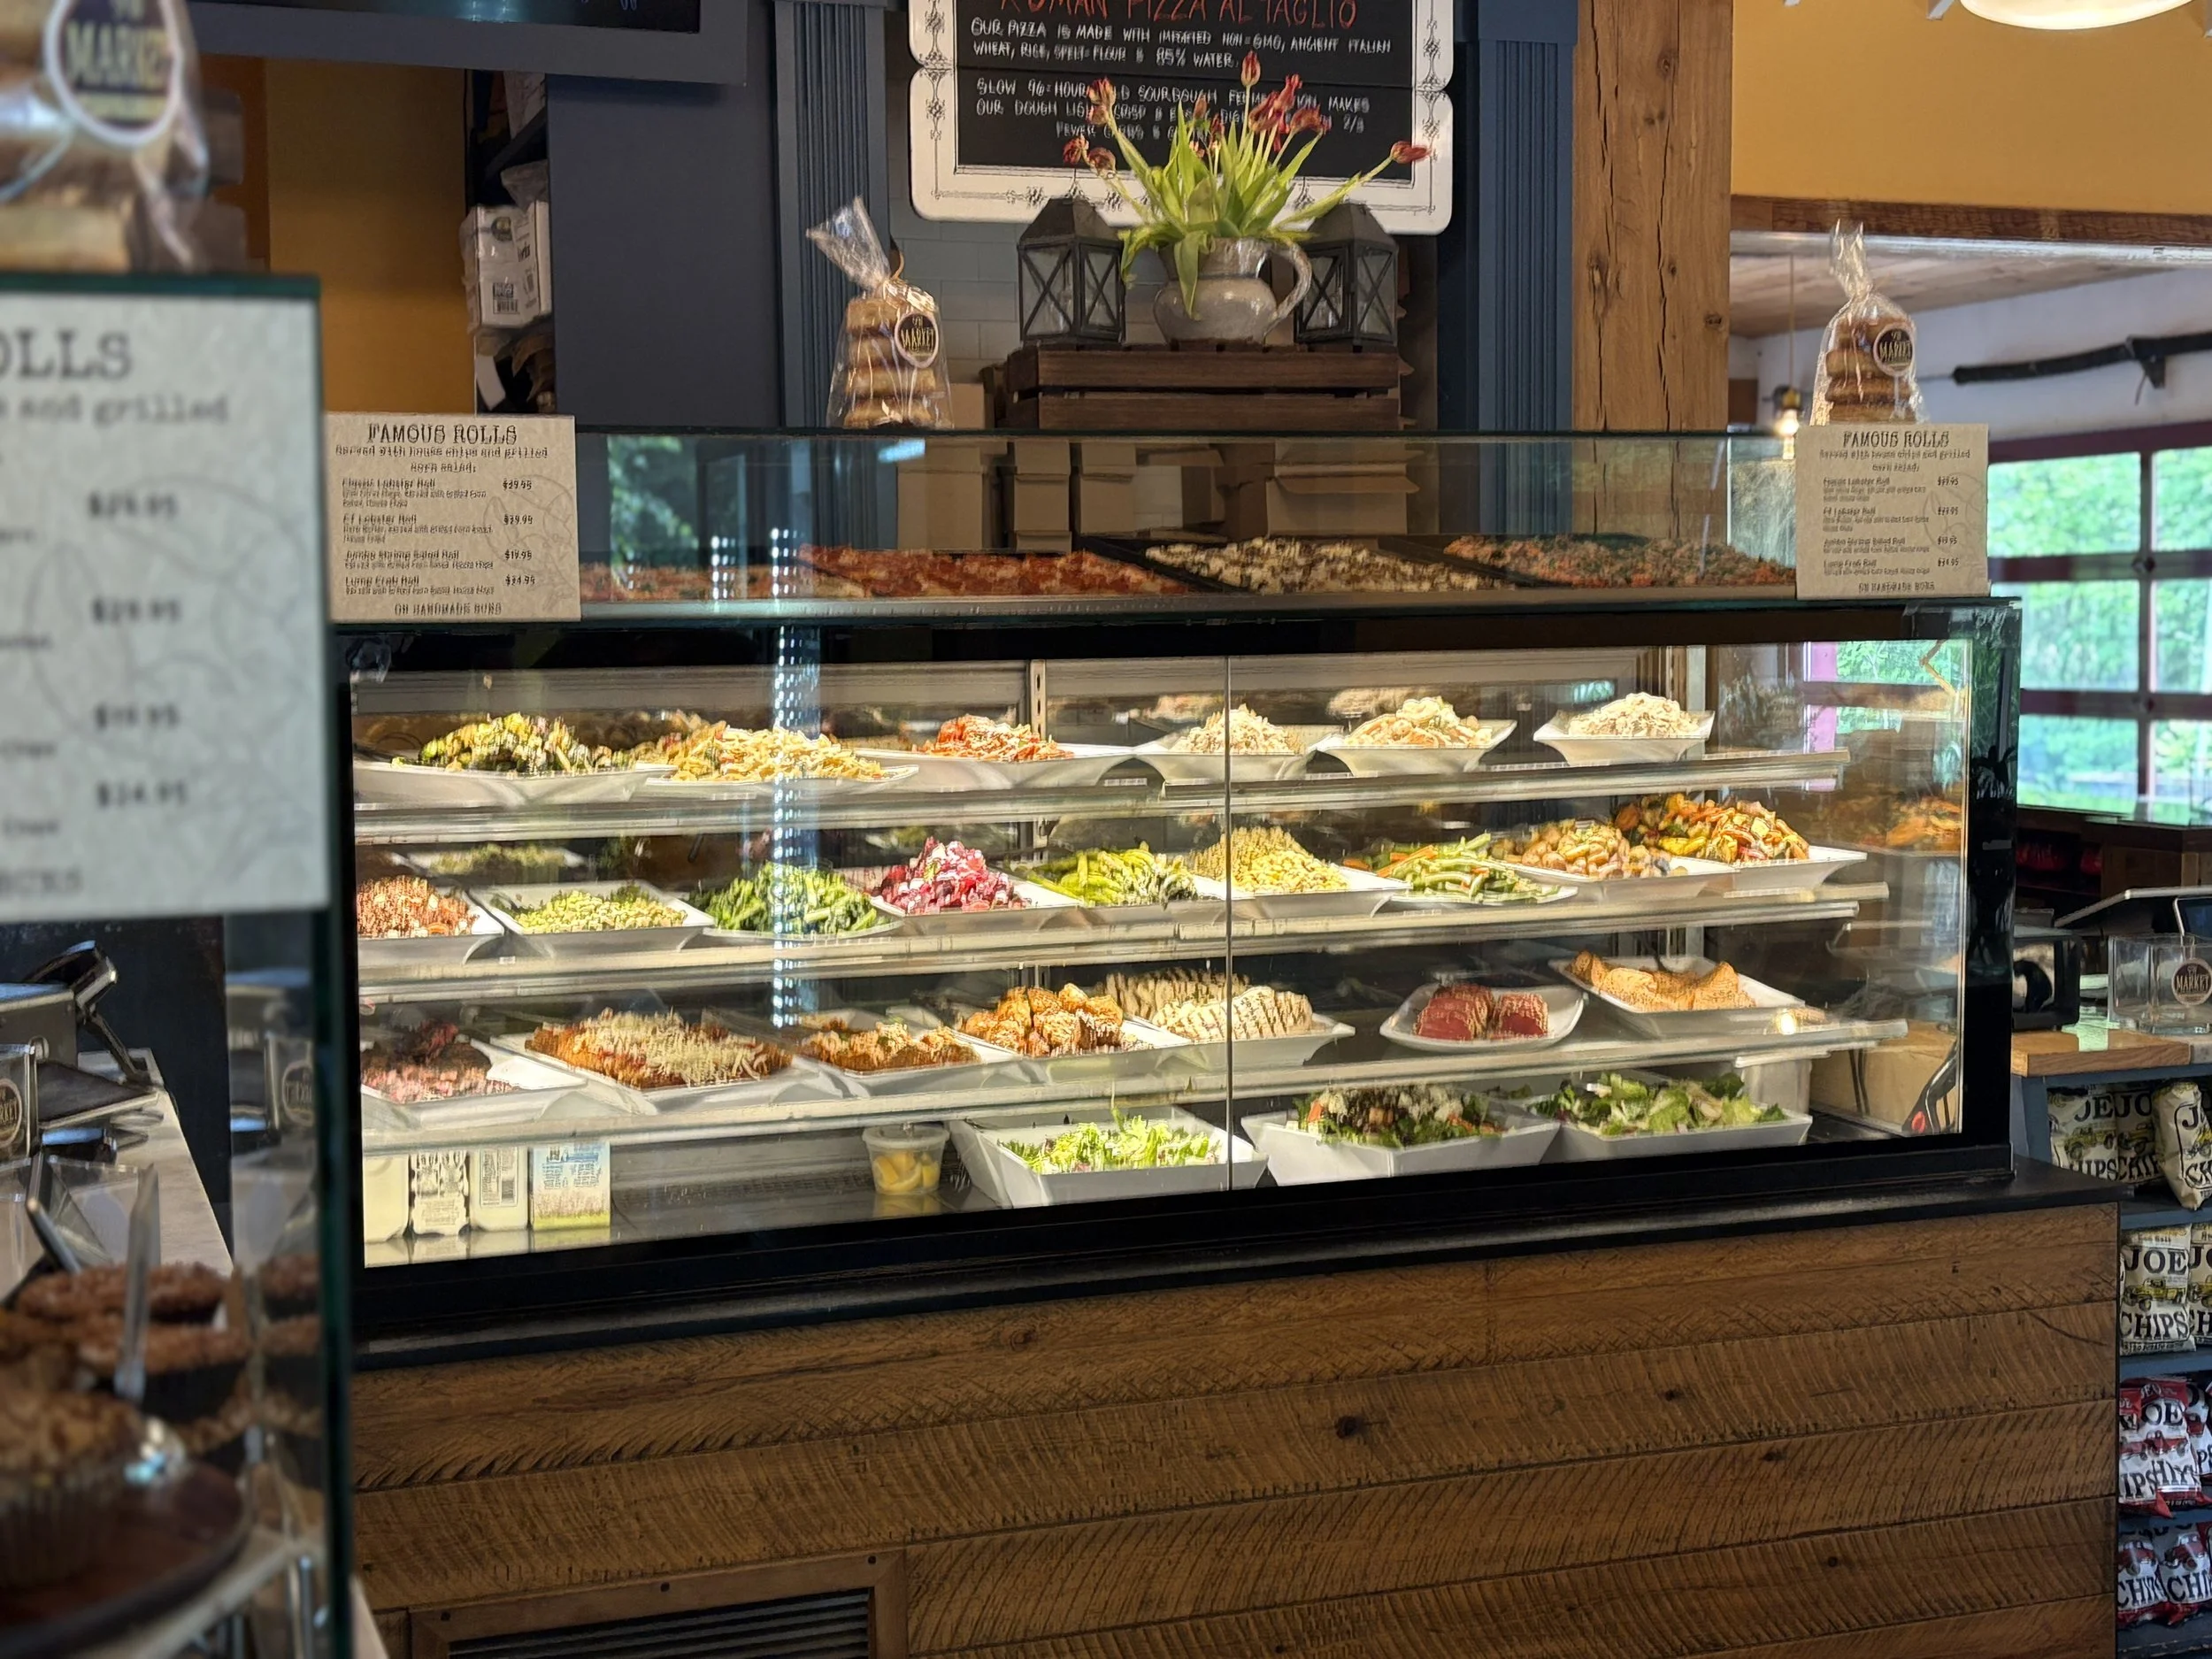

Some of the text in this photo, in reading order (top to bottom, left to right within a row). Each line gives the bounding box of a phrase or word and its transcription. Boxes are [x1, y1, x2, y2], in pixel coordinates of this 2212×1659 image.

[1127, 0, 1206, 21] PIZZA
[1219, 0, 1253, 24] AL
[1263, 0, 1357, 29] TAGLIO
[971, 17, 1002, 36] OUR
[1008, 19, 1047, 38] PIZZA
[1057, 24, 1071, 40] IS
[1076, 25, 1112, 41] MADE
[1123, 27, 1150, 43] WITH
[1290, 38, 1340, 53] ANCIENT
[1348, 39, 1391, 54] ITALIAN
[977, 77, 1016, 96] SLOW
[1138, 85, 1217, 105] SOURDOUH
[1329, 96, 1370, 114] MAKES
[976, 98, 1003, 116] OUR
[1015, 99, 1057, 117] DOUGH
[367, 423, 518, 445] FAMOUS ROLLS
[1842, 431, 1949, 448] FAMOUS ROLLS
[504, 447, 548, 460] grilled
[413, 603, 471, 616] HANDMADE
[2176, 974, 2208, 993] MARKET
[2124, 1248, 2187, 1275] JOE
[2119, 1310, 2190, 1340] CHIPS
[2142, 1402, 2184, 1426] OE
